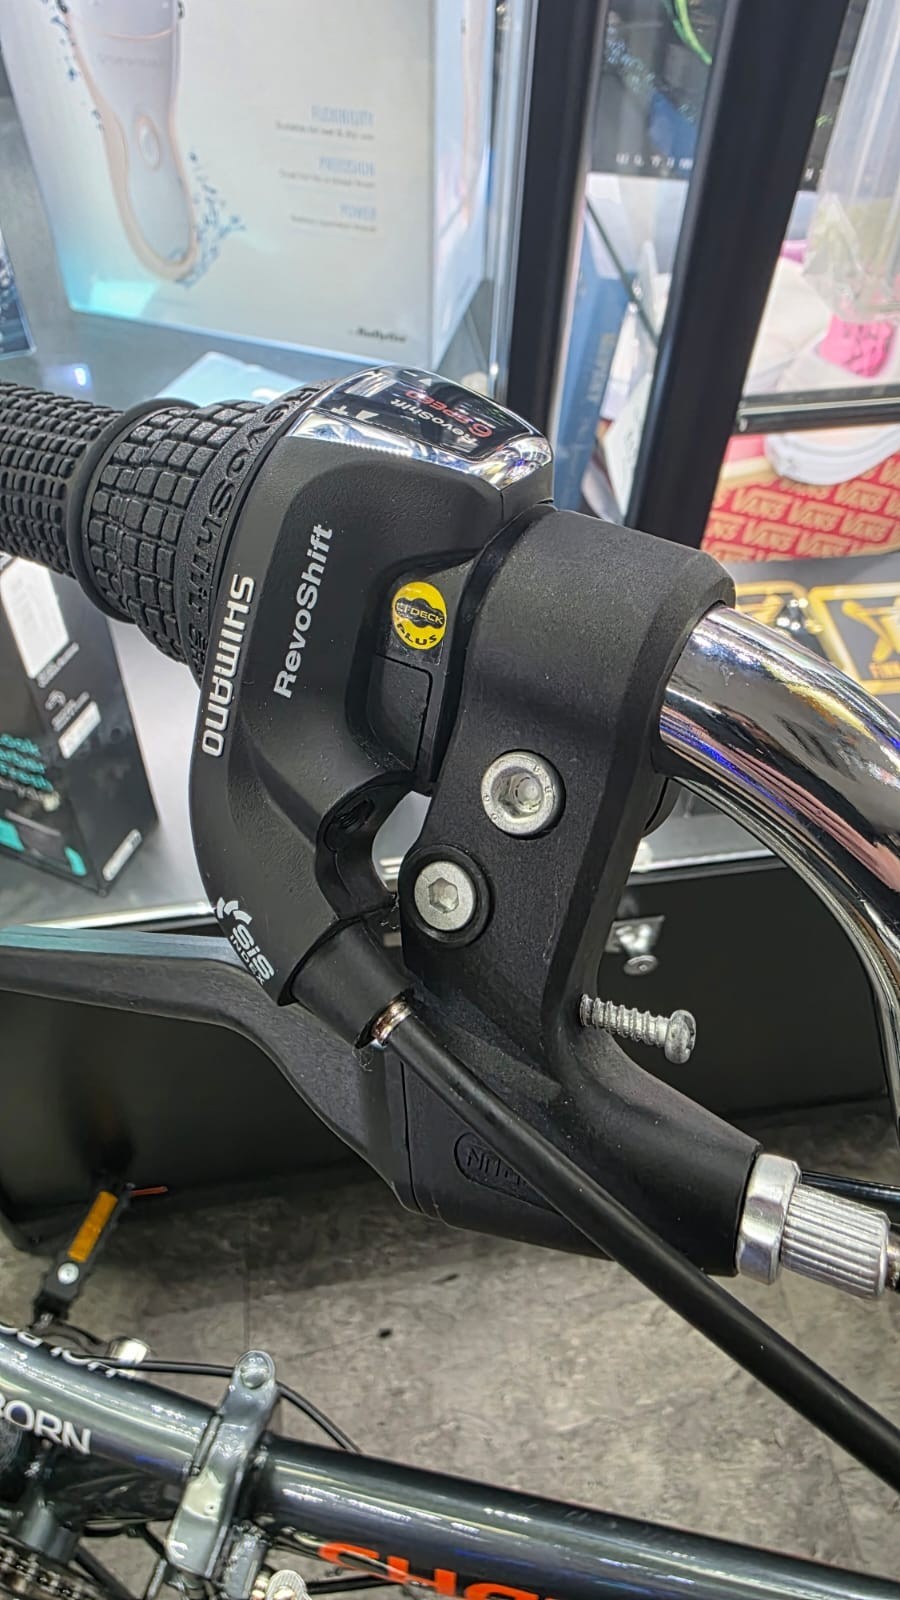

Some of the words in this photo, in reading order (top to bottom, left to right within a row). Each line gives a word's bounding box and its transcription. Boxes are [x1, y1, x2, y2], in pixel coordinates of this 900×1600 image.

[201, 573, 255, 758] SHIMANO
[273, 523, 333, 699] RevoShift
[397, 623, 438, 646] PLUS
